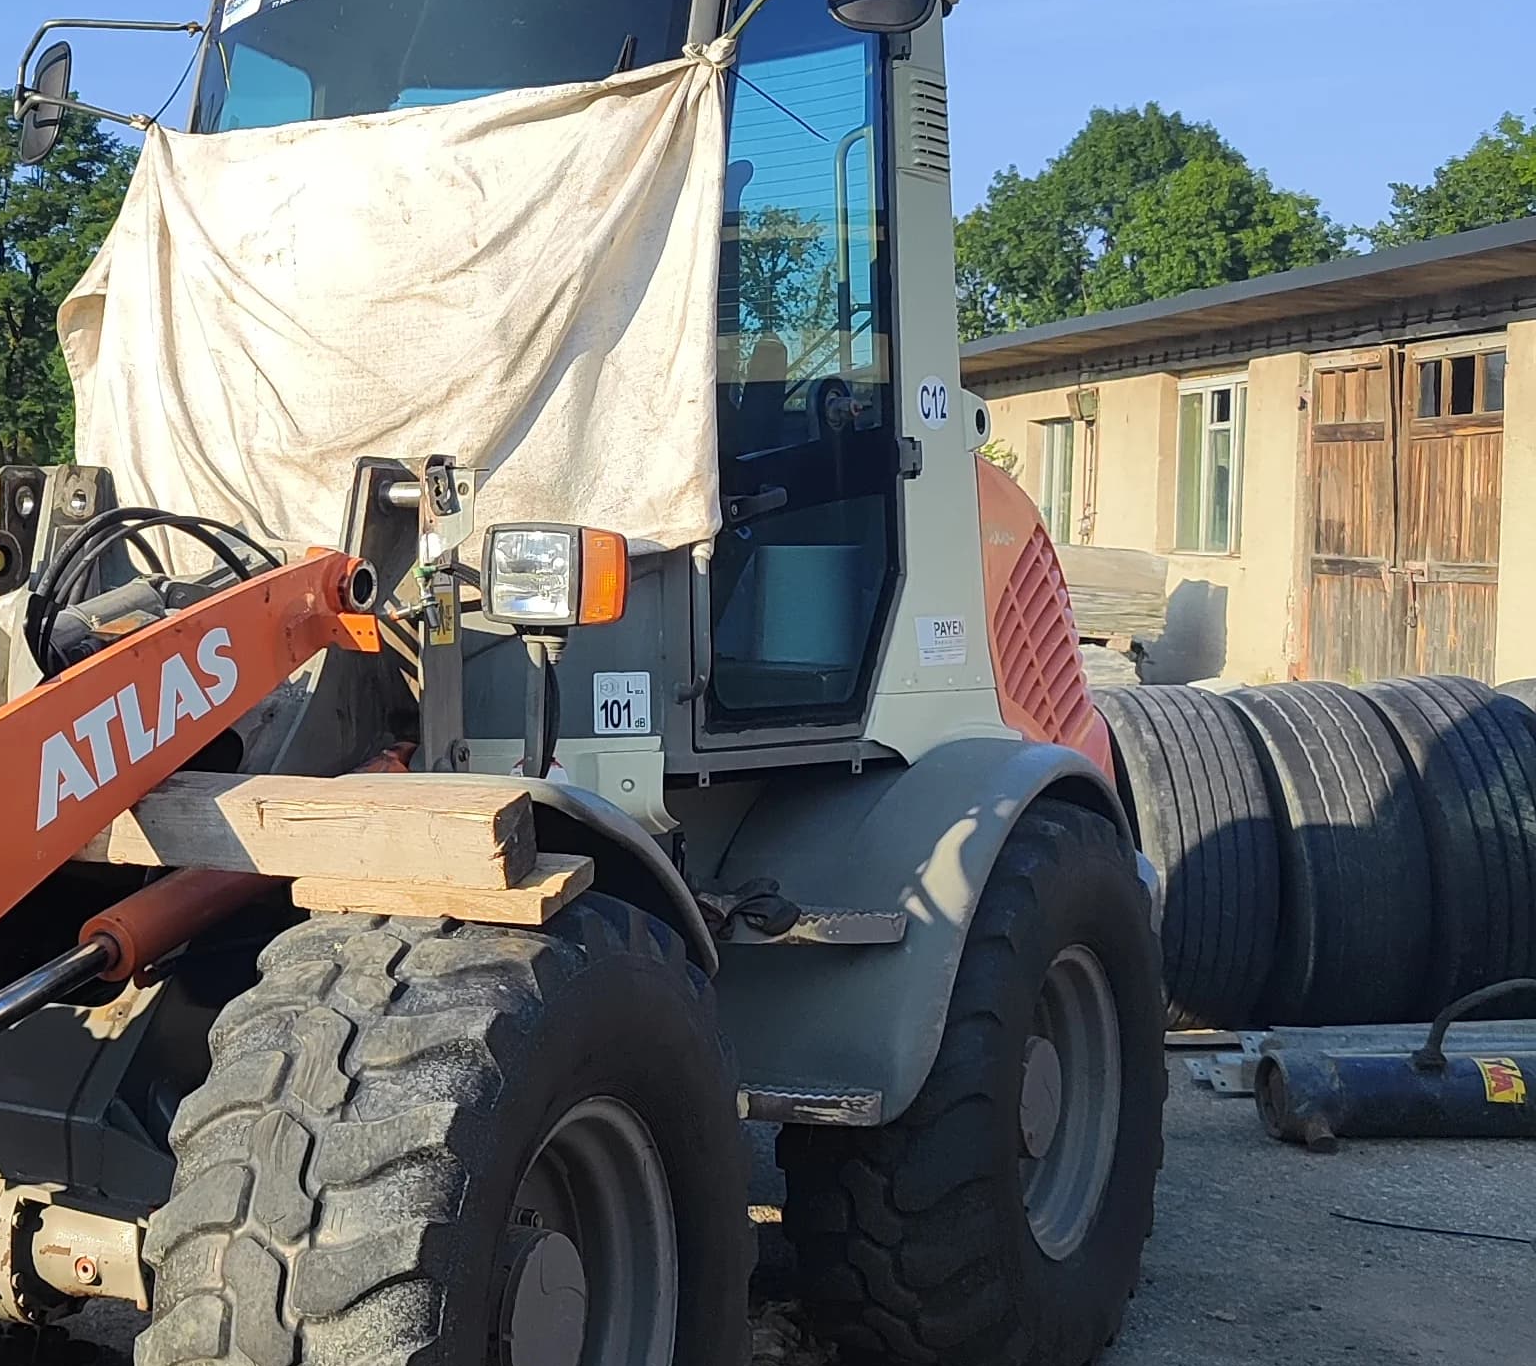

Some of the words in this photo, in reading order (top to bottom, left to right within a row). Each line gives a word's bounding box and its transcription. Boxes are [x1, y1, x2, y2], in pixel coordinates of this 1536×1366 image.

[920, 385, 947, 419] C12
[934, 620, 964, 636] PAYEN
[600, 699, 631, 728] 101
[634, 717, 645, 727] dB
[36, 627, 239, 832] ATLAS
